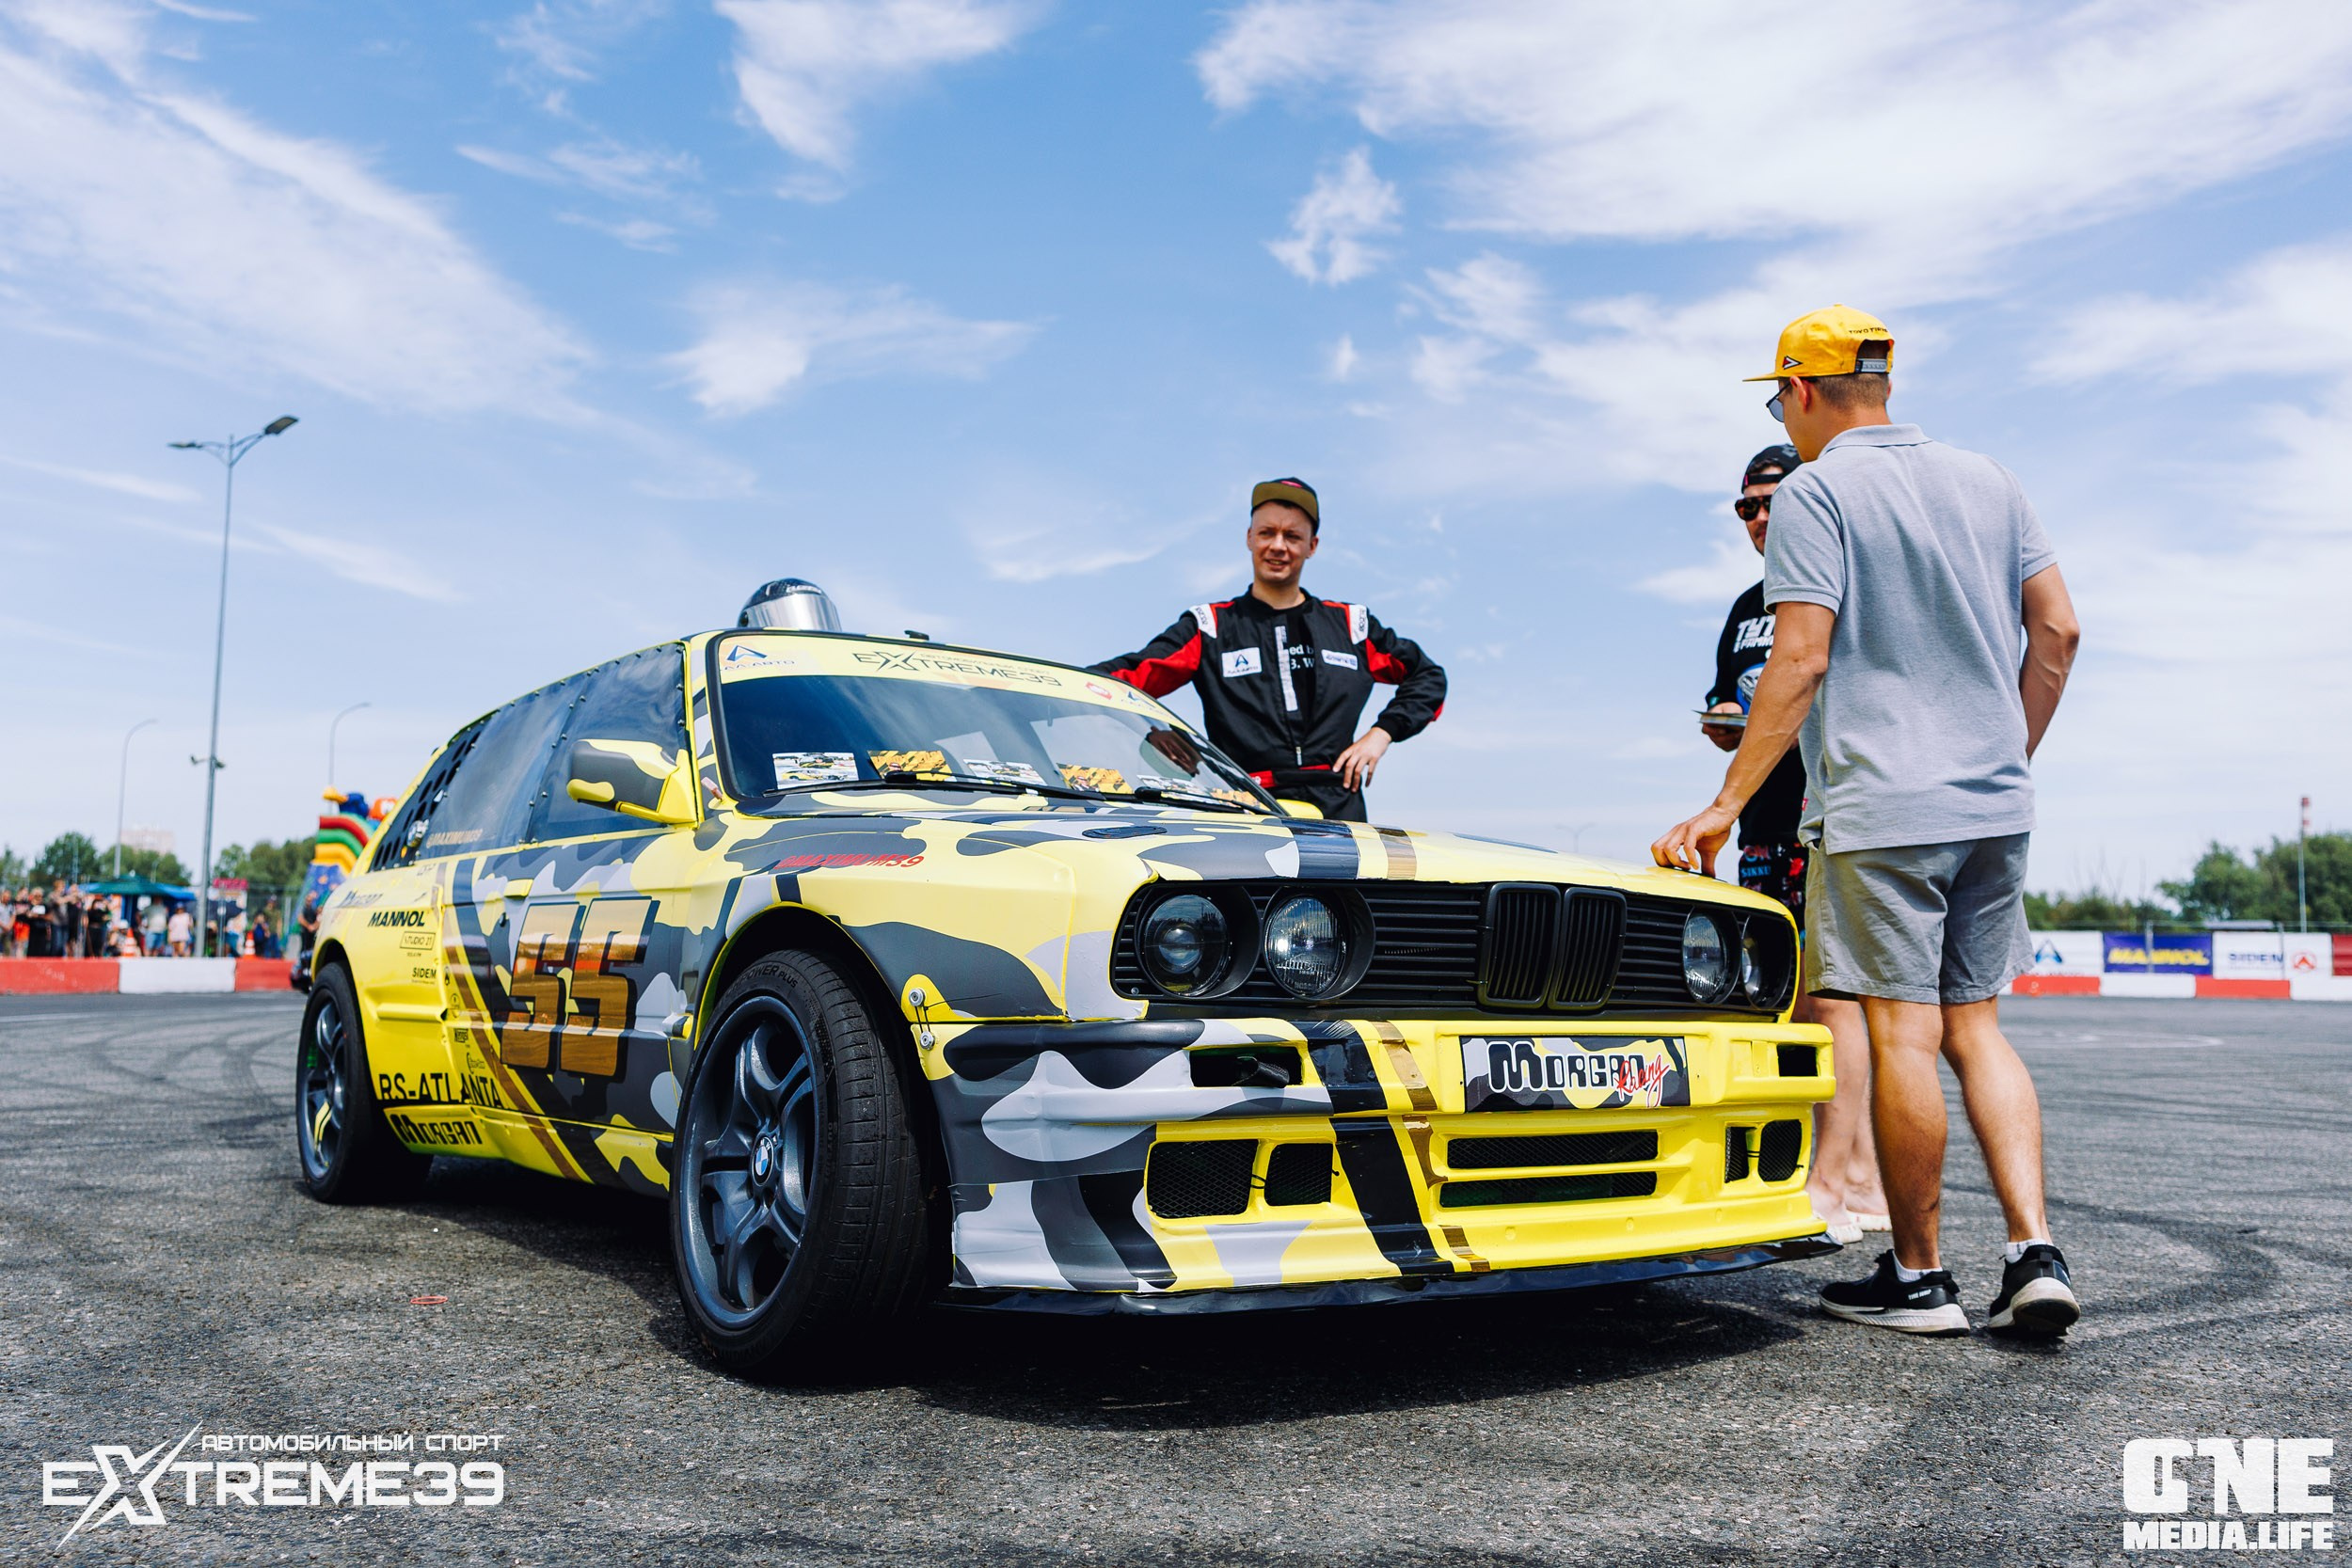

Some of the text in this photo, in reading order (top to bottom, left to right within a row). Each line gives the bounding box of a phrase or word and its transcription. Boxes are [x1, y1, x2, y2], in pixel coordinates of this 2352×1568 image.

[852, 650, 1062, 687] EXTREME39
[367, 911, 425, 927] MANNOL
[2108, 947, 2210, 965] MANNOL
[500, 896, 661, 1084] 55
[777, 972, 799, 988] PLUS
[1488, 1040, 1646, 1092] MORGAN
[378, 1072, 505, 1110] RS-ATLANTA
